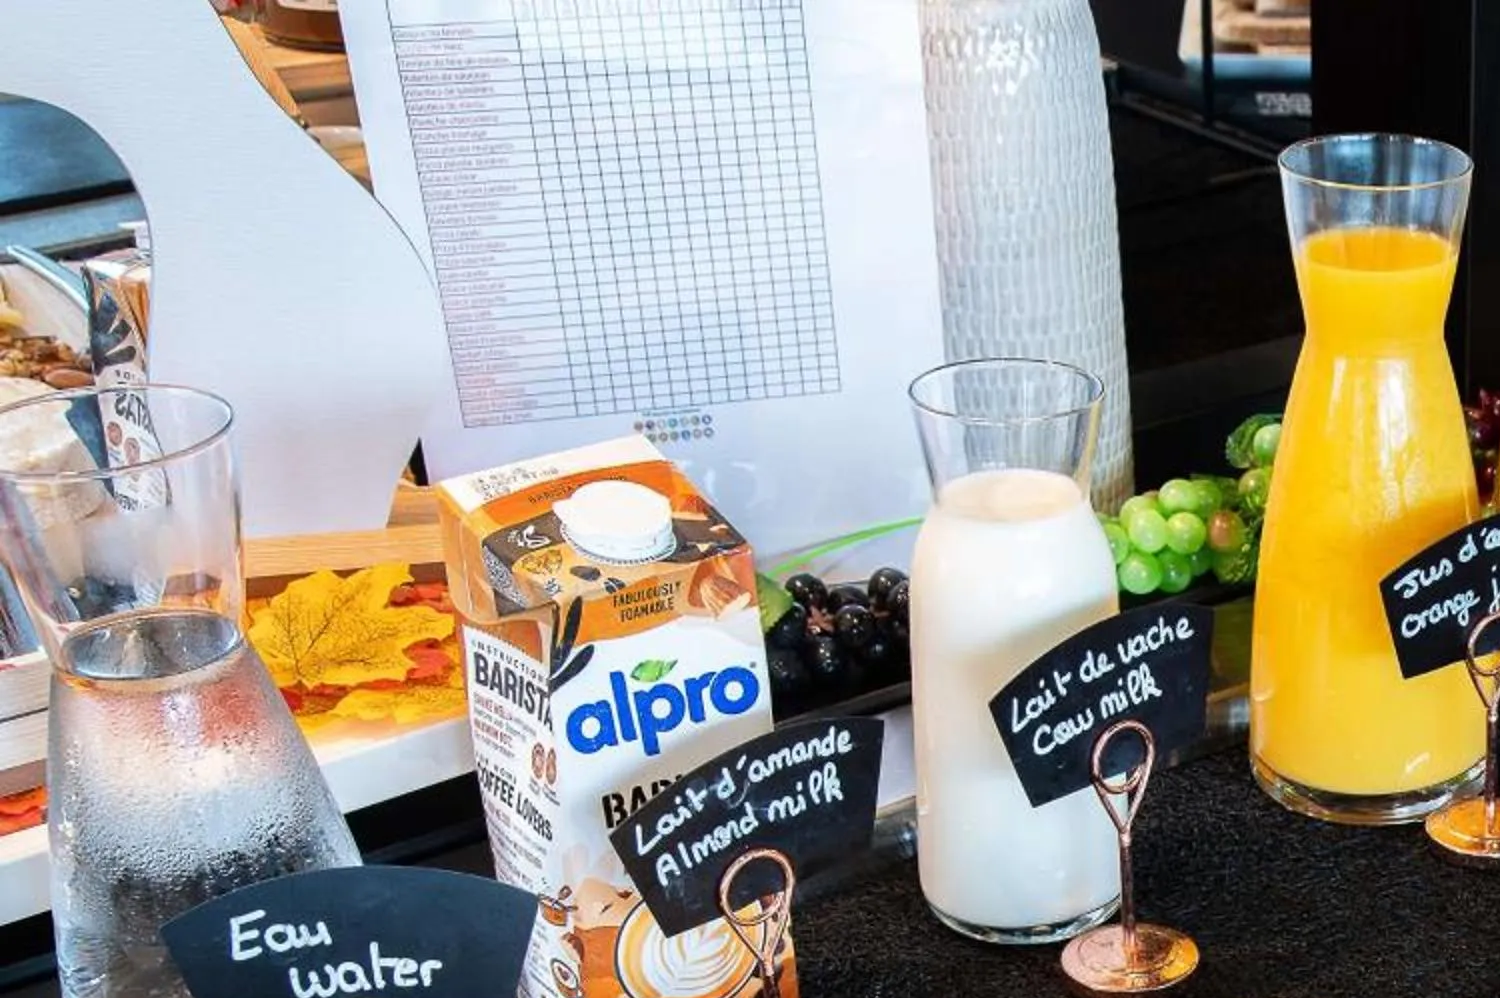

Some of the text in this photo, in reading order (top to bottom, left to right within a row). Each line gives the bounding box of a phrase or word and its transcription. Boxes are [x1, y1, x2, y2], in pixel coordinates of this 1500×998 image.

[1393, 557, 1453, 598] Jus
[471, 640, 550, 682] INSTRUCTION
[1011, 616, 1194, 733] Lait de vache
[566, 666, 760, 756] alpro
[1032, 662, 1162, 755] Cow milk
[635, 785, 708, 856] Lait
[655, 802, 759, 886] Almond
[767, 762, 844, 822] milk
[229, 909, 332, 962] Eau
